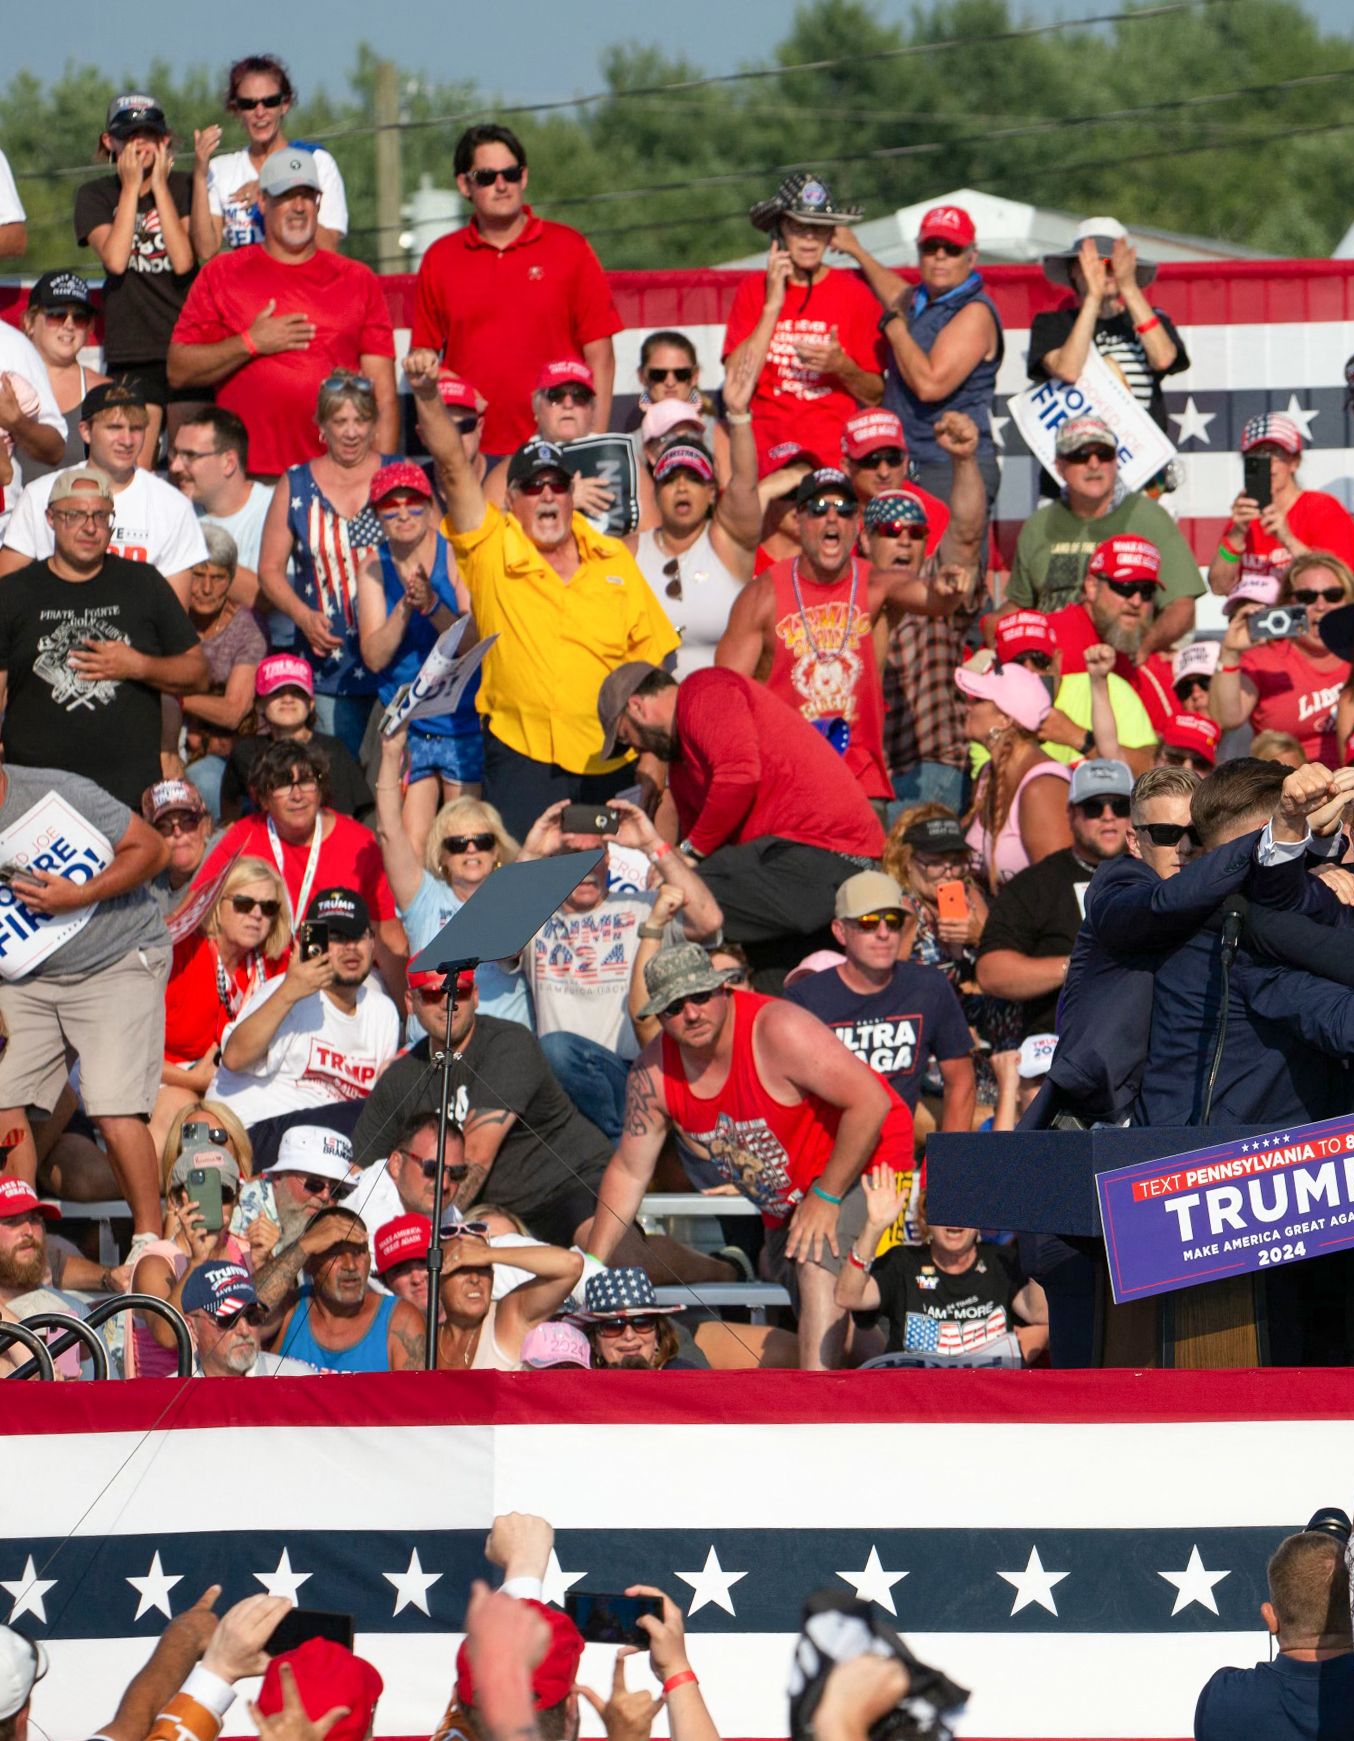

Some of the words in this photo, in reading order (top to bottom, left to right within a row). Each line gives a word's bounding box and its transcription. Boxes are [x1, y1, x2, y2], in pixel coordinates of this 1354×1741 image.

[39, 609, 75, 621] PIRATE
[84, 605, 120, 619] POINTE
[70, 615, 97, 627] GOLF
[34, 827, 57, 856] JOE
[317, 900, 356, 911] TRUMP
[1139, 1176, 1182, 1198] TEXT
[1186, 1145, 1315, 1187] PENNSYLVANIA
[1318, 1140, 1341, 1157] TO
[1182, 1245, 1220, 1262] MAKE
[1223, 1231, 1281, 1253] AMERICA
[1284, 1219, 1326, 1239] GREAT
[1257, 1242, 1307, 1267] 2024
[928, 1305, 948, 1320] AM
[954, 1301, 995, 1320] MORE
[550, 1339, 586, 1357] 2024
